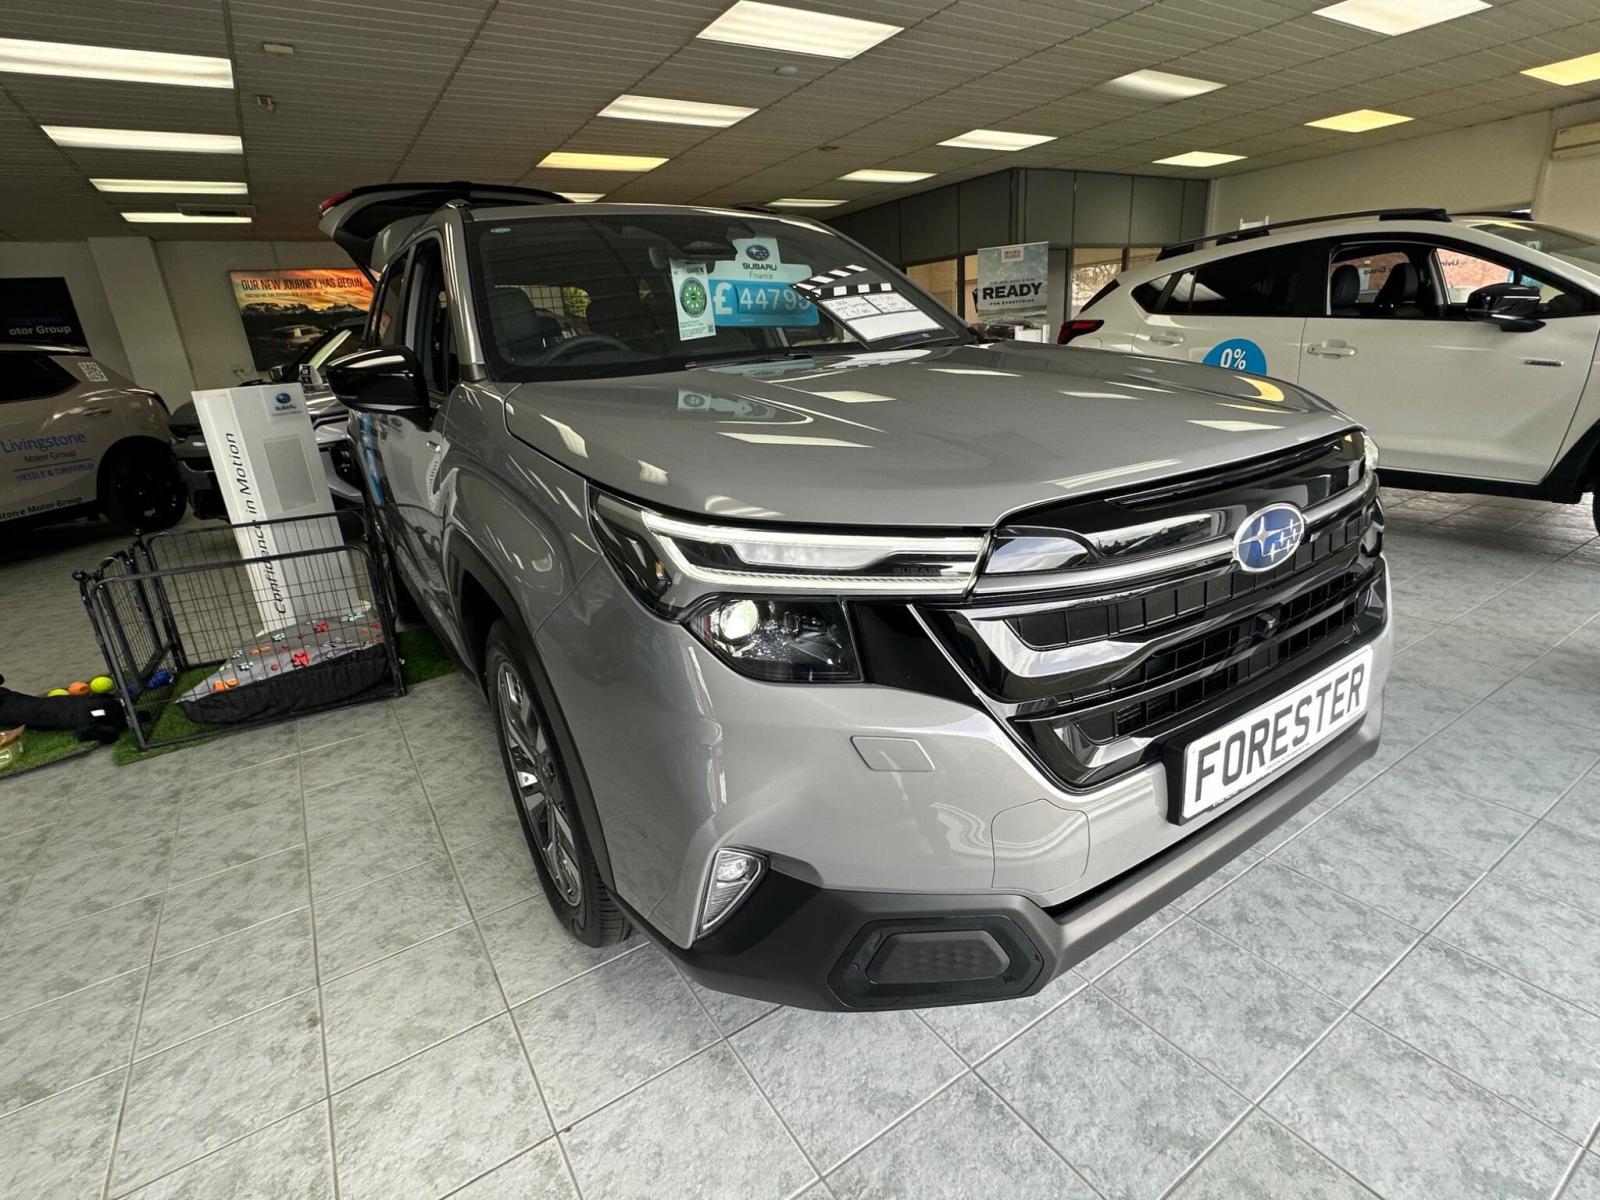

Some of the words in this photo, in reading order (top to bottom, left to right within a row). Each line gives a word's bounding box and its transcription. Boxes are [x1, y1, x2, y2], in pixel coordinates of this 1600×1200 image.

[742, 262, 777, 271] SUBARU
[241, 279, 260, 291] OUR
[260, 279, 281, 290] NEW
[283, 277, 318, 290] JOURNEY
[319, 277, 336, 289] HAS
[336, 276, 363, 288] BEGUN
[749, 271, 774, 280] Finance
[982, 281, 1043, 300] READY
[35, 325, 72, 336] Group
[1220, 348, 1247, 370] 0%
[0, 433, 87, 453] Livingstone
[49, 450, 77, 461] Group
[226, 432, 251, 495] Motion
[27, 502, 55, 513] Motor
[56, 496, 82, 507] Group
[246, 500, 257, 514] in
[1194, 662, 1365, 803] FORESTER
